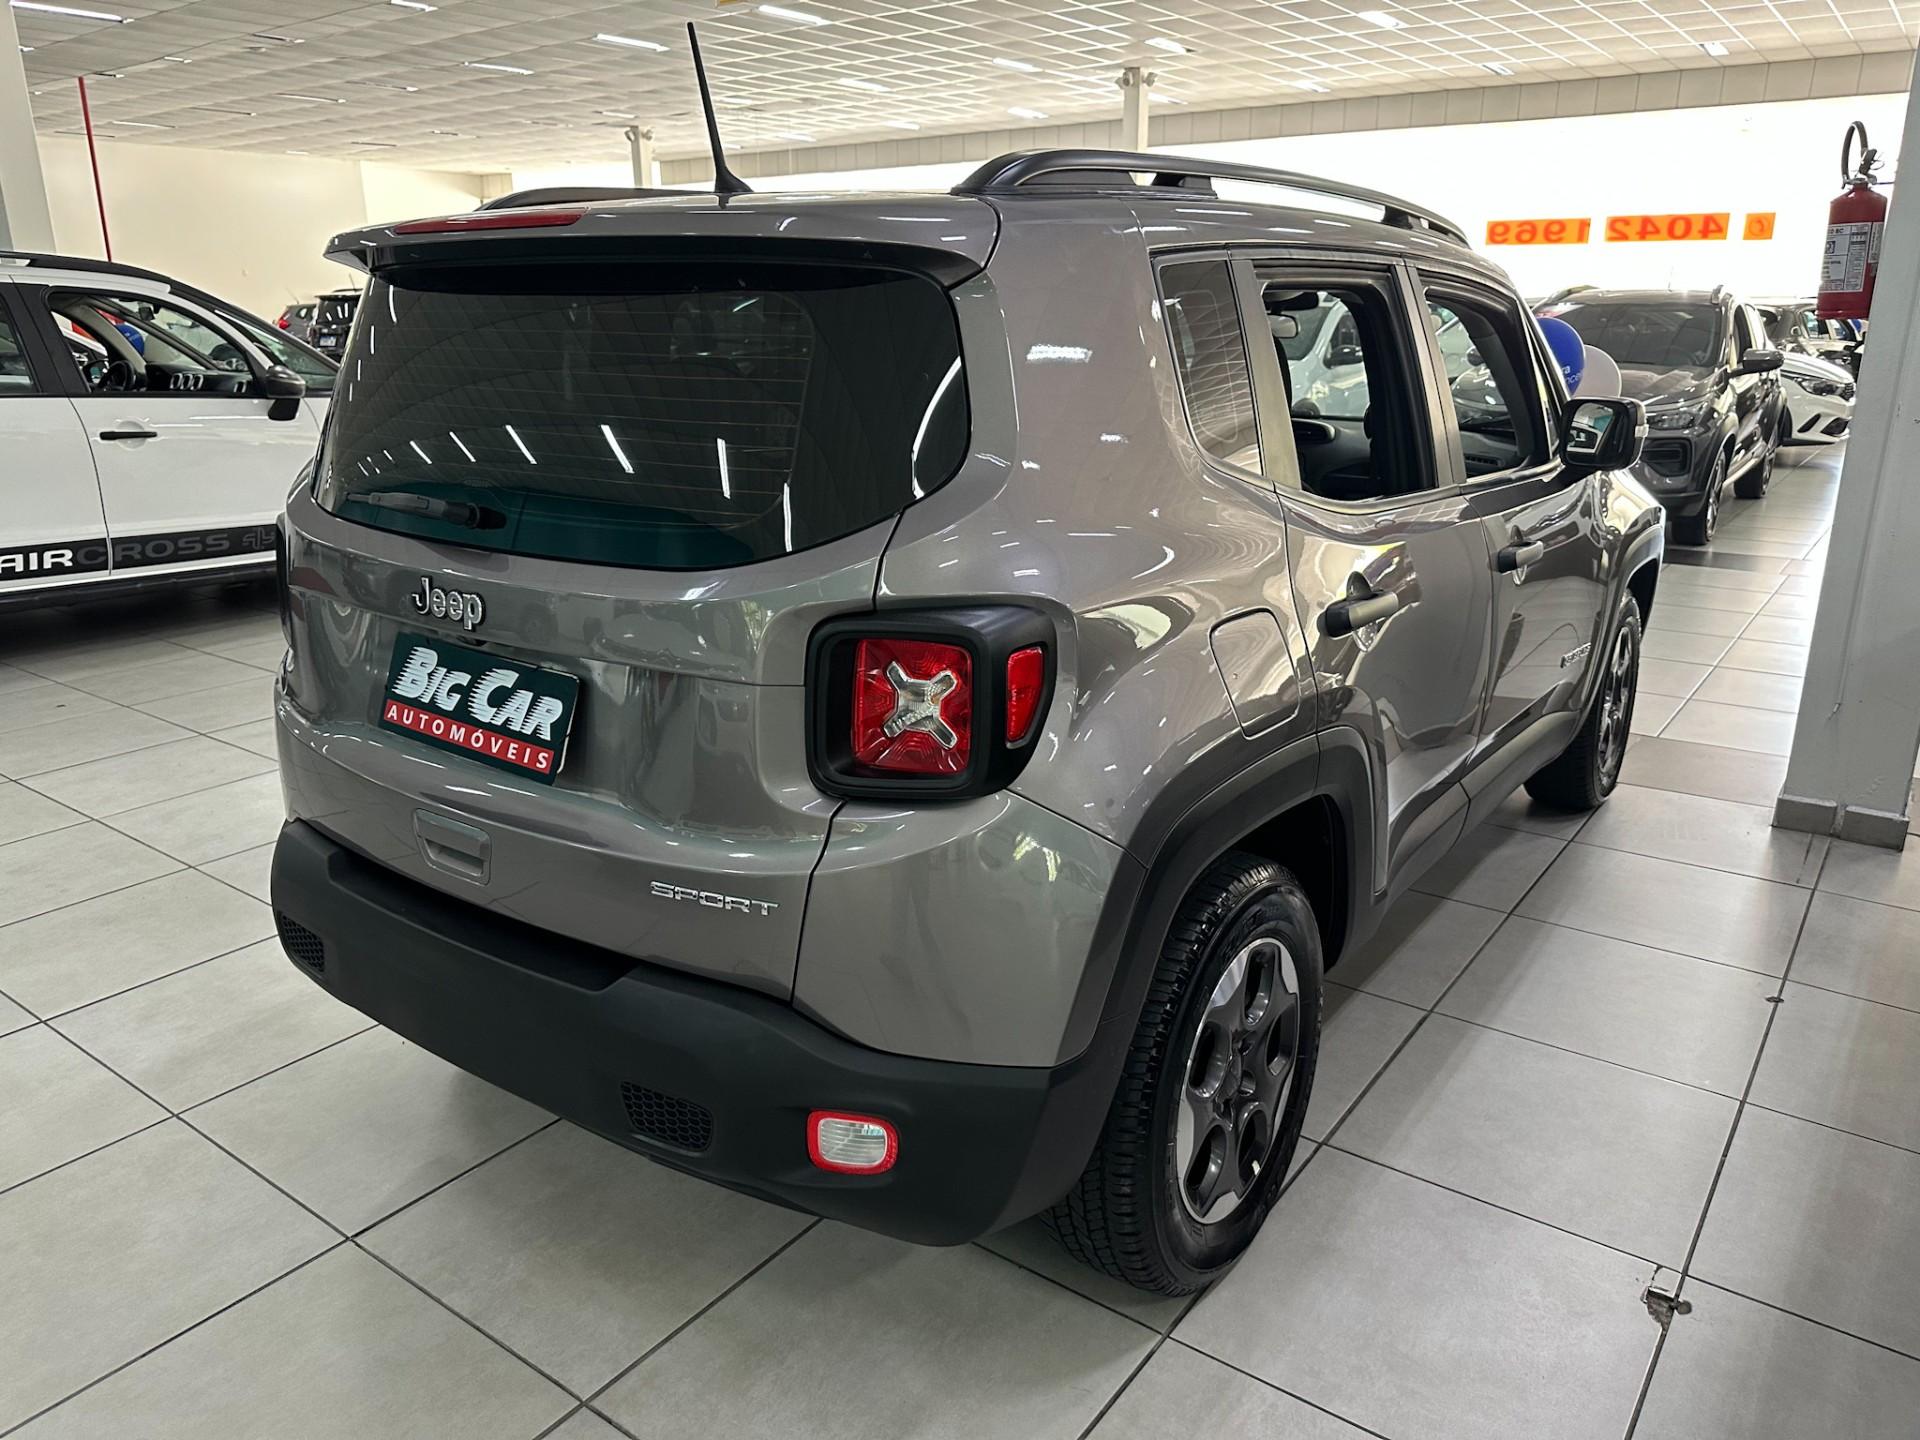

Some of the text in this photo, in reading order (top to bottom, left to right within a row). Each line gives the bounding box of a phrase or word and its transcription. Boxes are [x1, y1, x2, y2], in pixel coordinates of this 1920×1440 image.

[0, 533, 229, 574] AIRCROSS
[411, 576, 483, 630] Jeep
[391, 645, 564, 741] BIG CAR
[386, 705, 549, 770] AUTOMÓVEIS
[650, 881, 779, 916] SPORT
